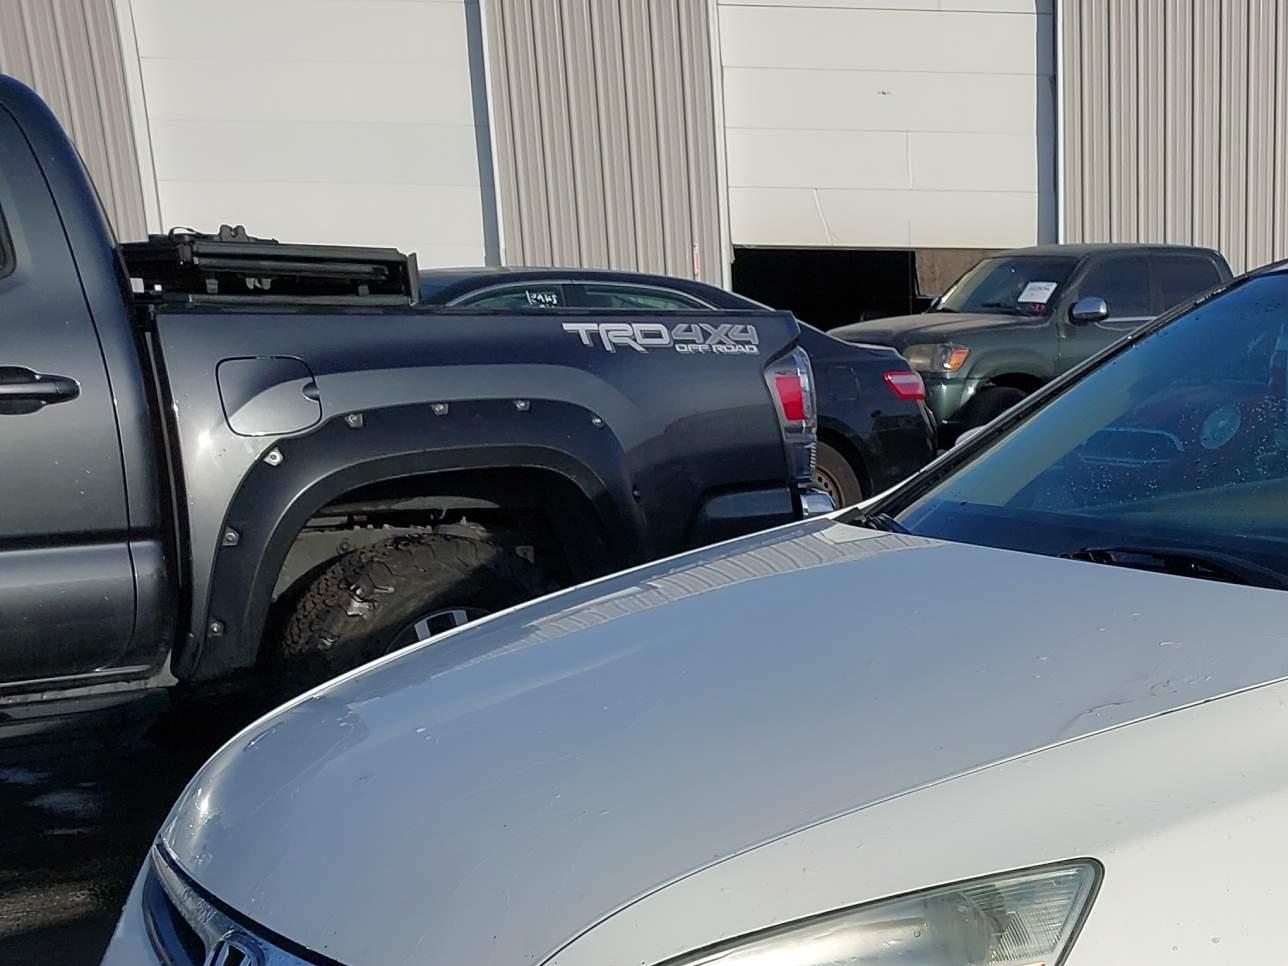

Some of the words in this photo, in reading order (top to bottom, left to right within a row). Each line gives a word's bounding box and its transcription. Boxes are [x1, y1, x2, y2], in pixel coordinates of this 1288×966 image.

[562, 322, 673, 352] TRD
[675, 343, 709, 353] OFF
[711, 343, 760, 354] ROAD
